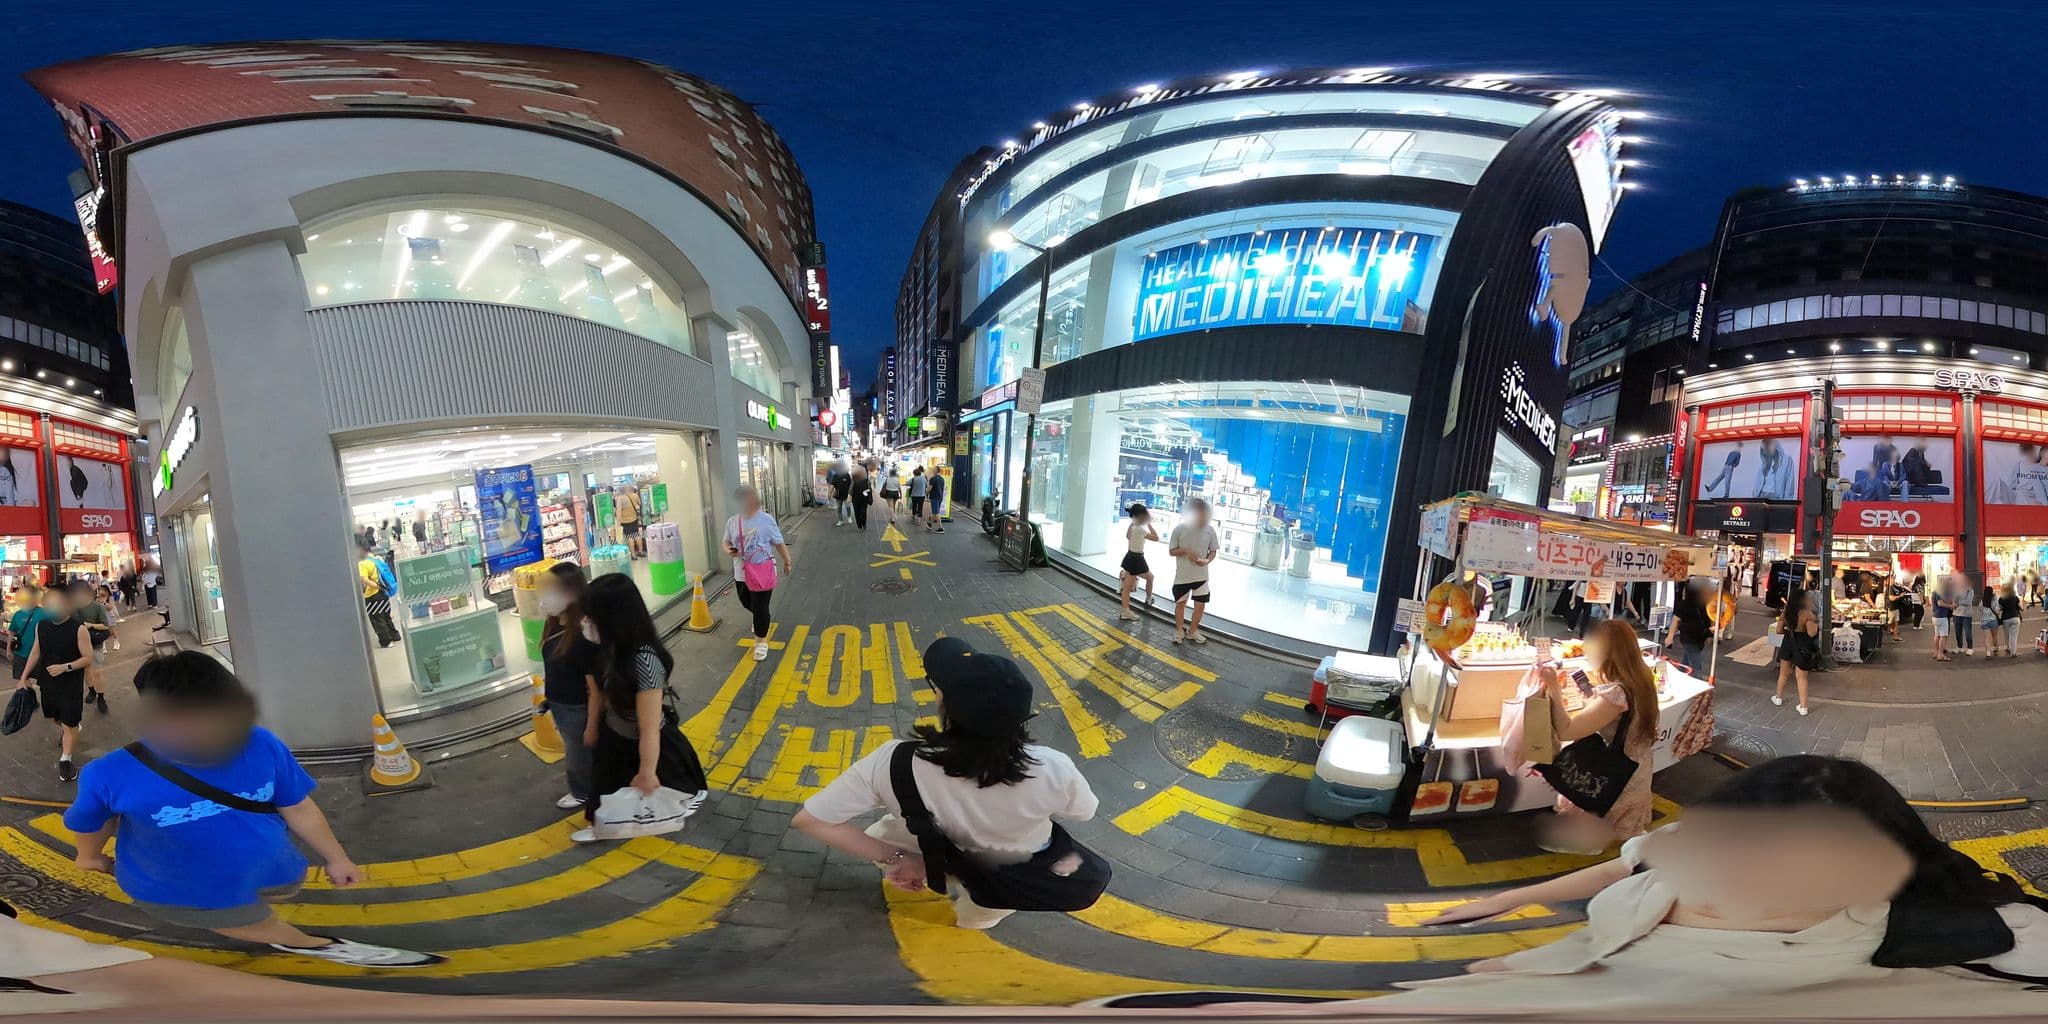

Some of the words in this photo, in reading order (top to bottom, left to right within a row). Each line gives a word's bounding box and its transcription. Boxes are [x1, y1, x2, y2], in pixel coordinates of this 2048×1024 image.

[1146, 248, 1265, 289] HEALING
[1284, 244, 1329, 267] ON
[1348, 244, 1417, 272] THE
[1139, 275, 1399, 336] MEDIHEAL
[810, 322, 822, 330] 3F
[887, 354, 895, 384] HOTEL
[936, 349, 948, 402] MEDIHEAL
[1934, 369, 2005, 393] SPAO
[887, 391, 895, 421] SAVOY
[1505, 375, 1556, 457] MEDIHEAL
[81, 514, 113, 527] SPAO
[1860, 509, 1921, 529] SPAO
